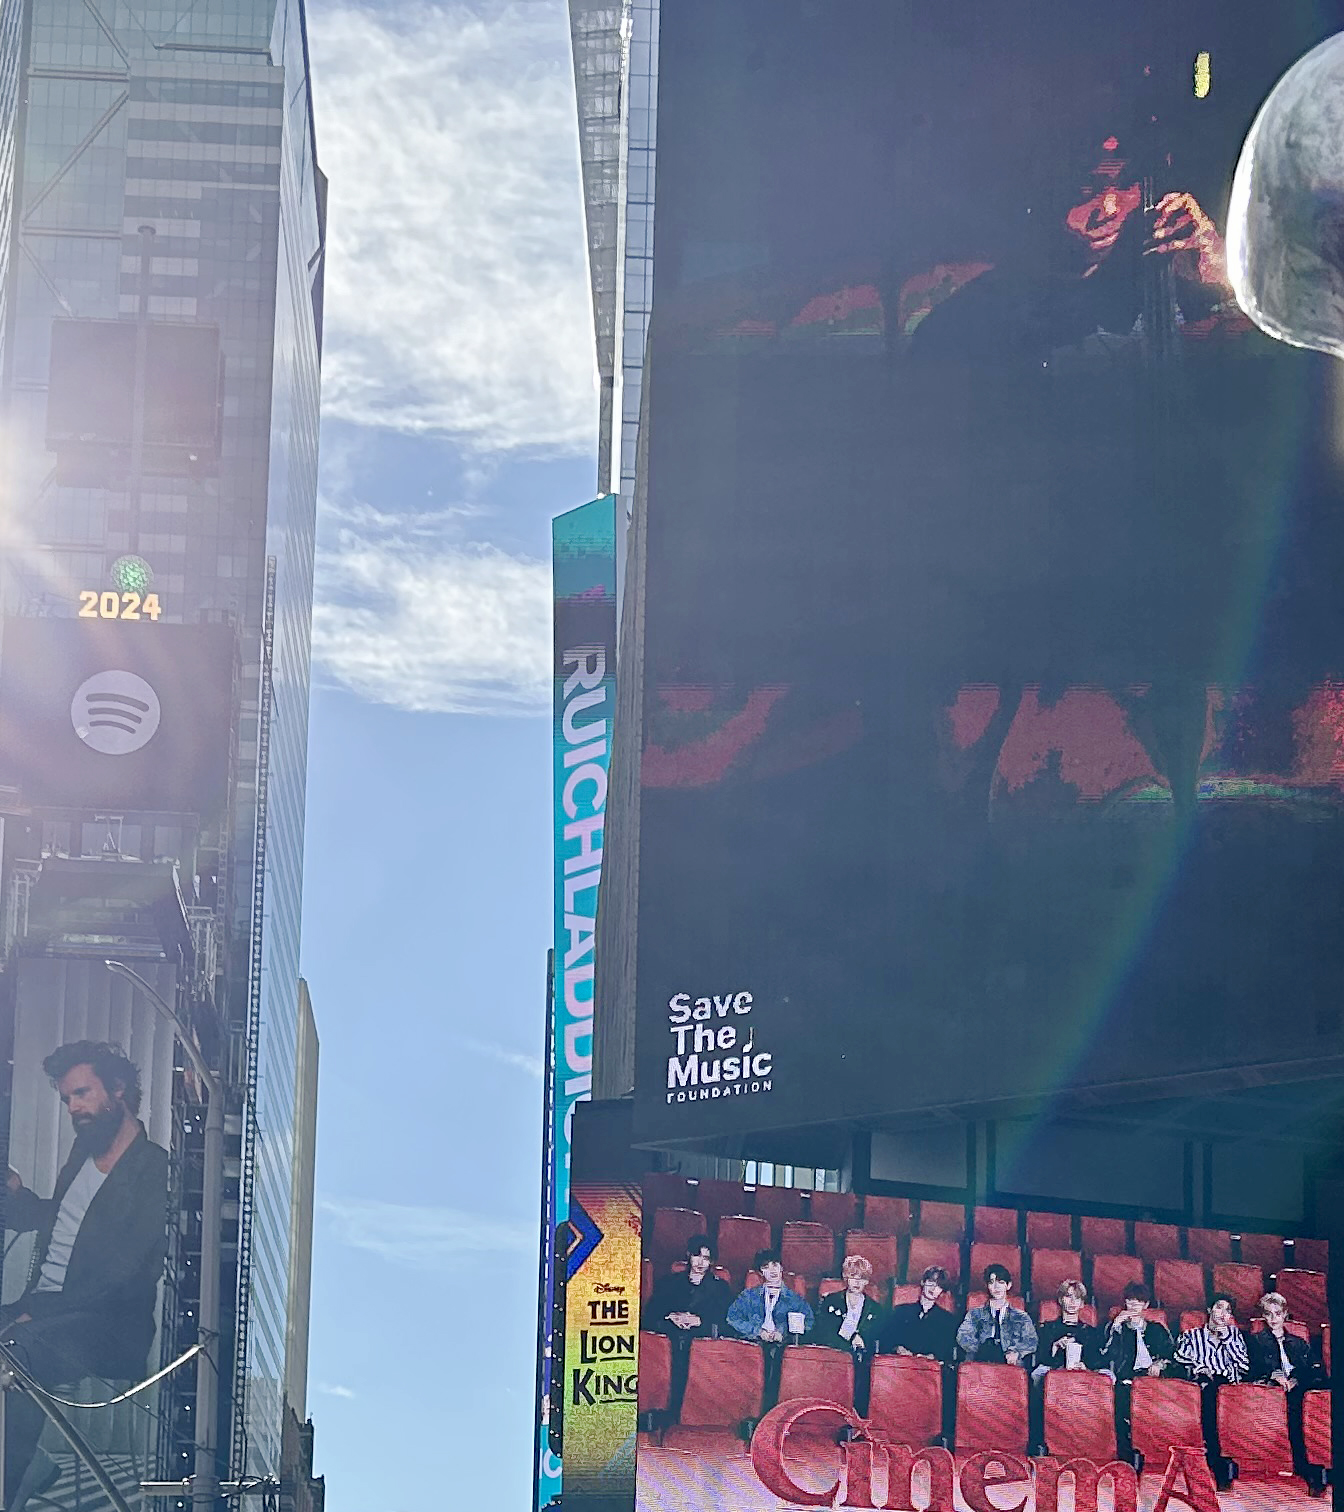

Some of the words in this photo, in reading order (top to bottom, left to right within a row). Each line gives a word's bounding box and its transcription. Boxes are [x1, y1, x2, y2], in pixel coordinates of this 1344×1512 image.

[78, 589, 162, 621] 2024
[668, 990, 754, 1024] Save
[669, 1024, 737, 1056] The
[666, 1051, 773, 1089] Music
[666, 1080, 773, 1104] FOUNDATION
[588, 1299, 629, 1320] THE
